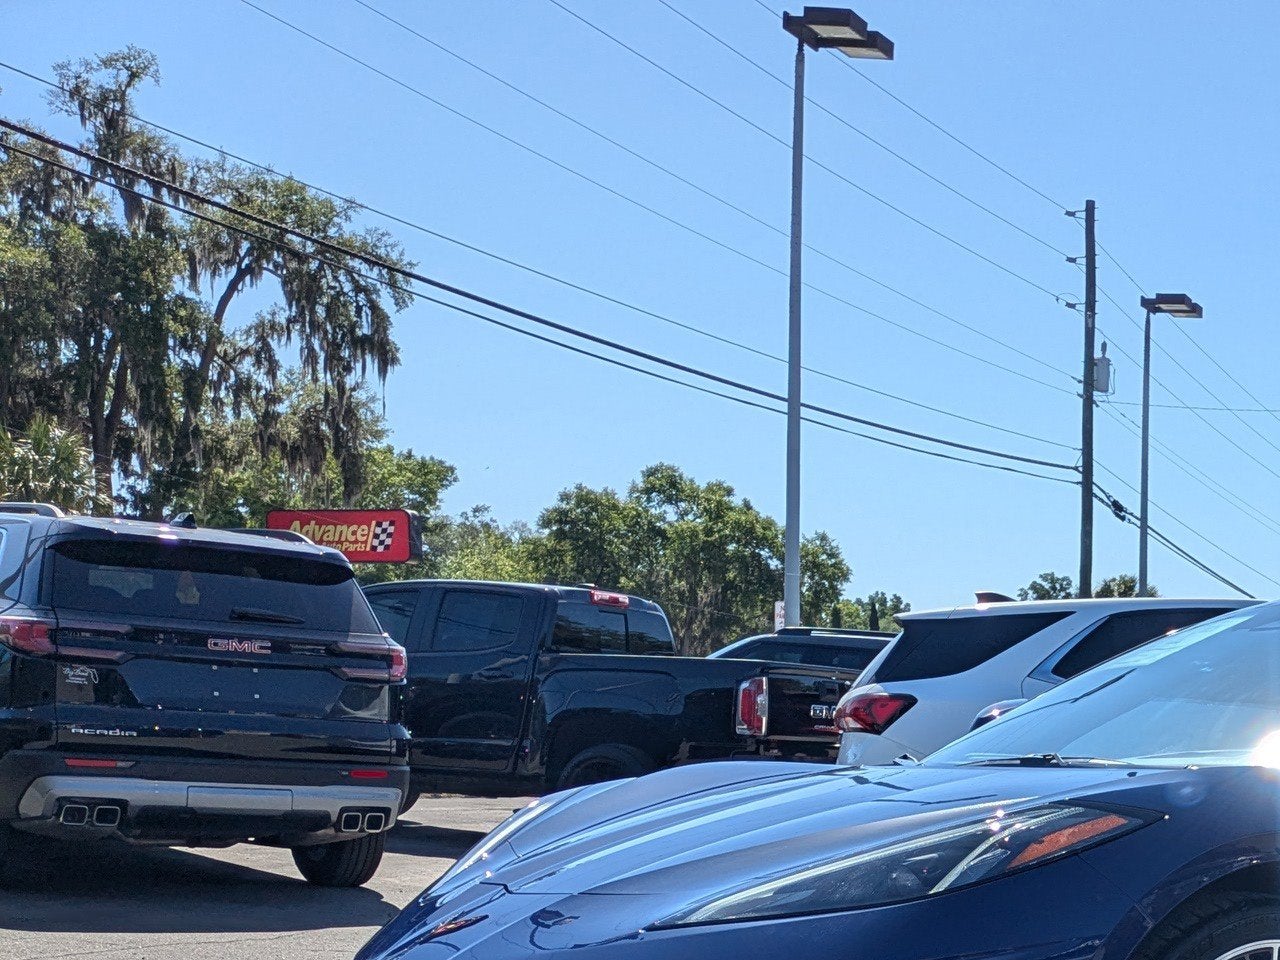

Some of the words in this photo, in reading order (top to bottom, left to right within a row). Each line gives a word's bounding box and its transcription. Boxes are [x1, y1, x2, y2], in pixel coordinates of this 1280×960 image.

[290, 520, 368, 541] Advance
[342, 541, 366, 551] Parts
[207, 638, 271, 654] GMC
[810, 704, 837, 719] GM
